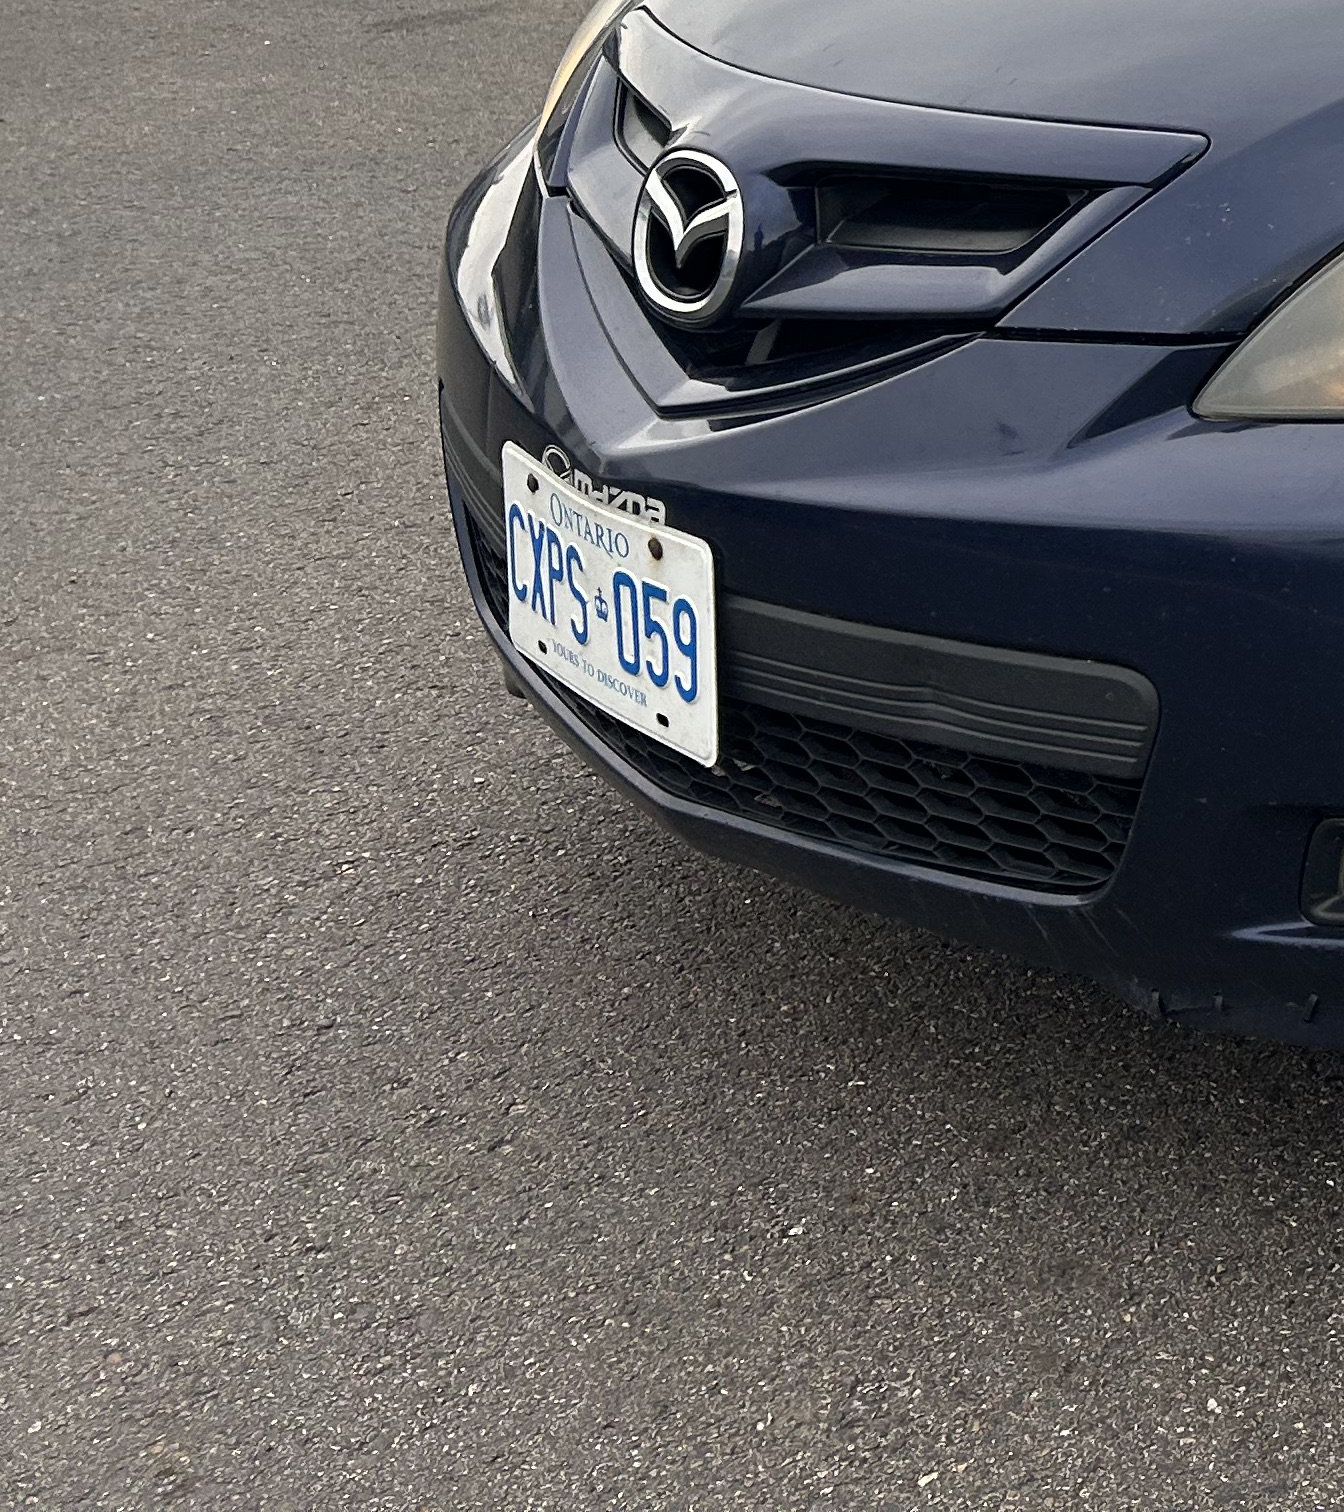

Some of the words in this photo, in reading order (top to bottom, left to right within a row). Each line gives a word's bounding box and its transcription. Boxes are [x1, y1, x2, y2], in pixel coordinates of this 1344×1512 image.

[550, 493, 630, 558] ONTARIO
[509, 503, 588, 645] CXPS
[612, 571, 698, 702] 059
[551, 640, 580, 668] YOURS
[582, 656, 595, 678] TO
[597, 668, 647, 707] DISCOVER
